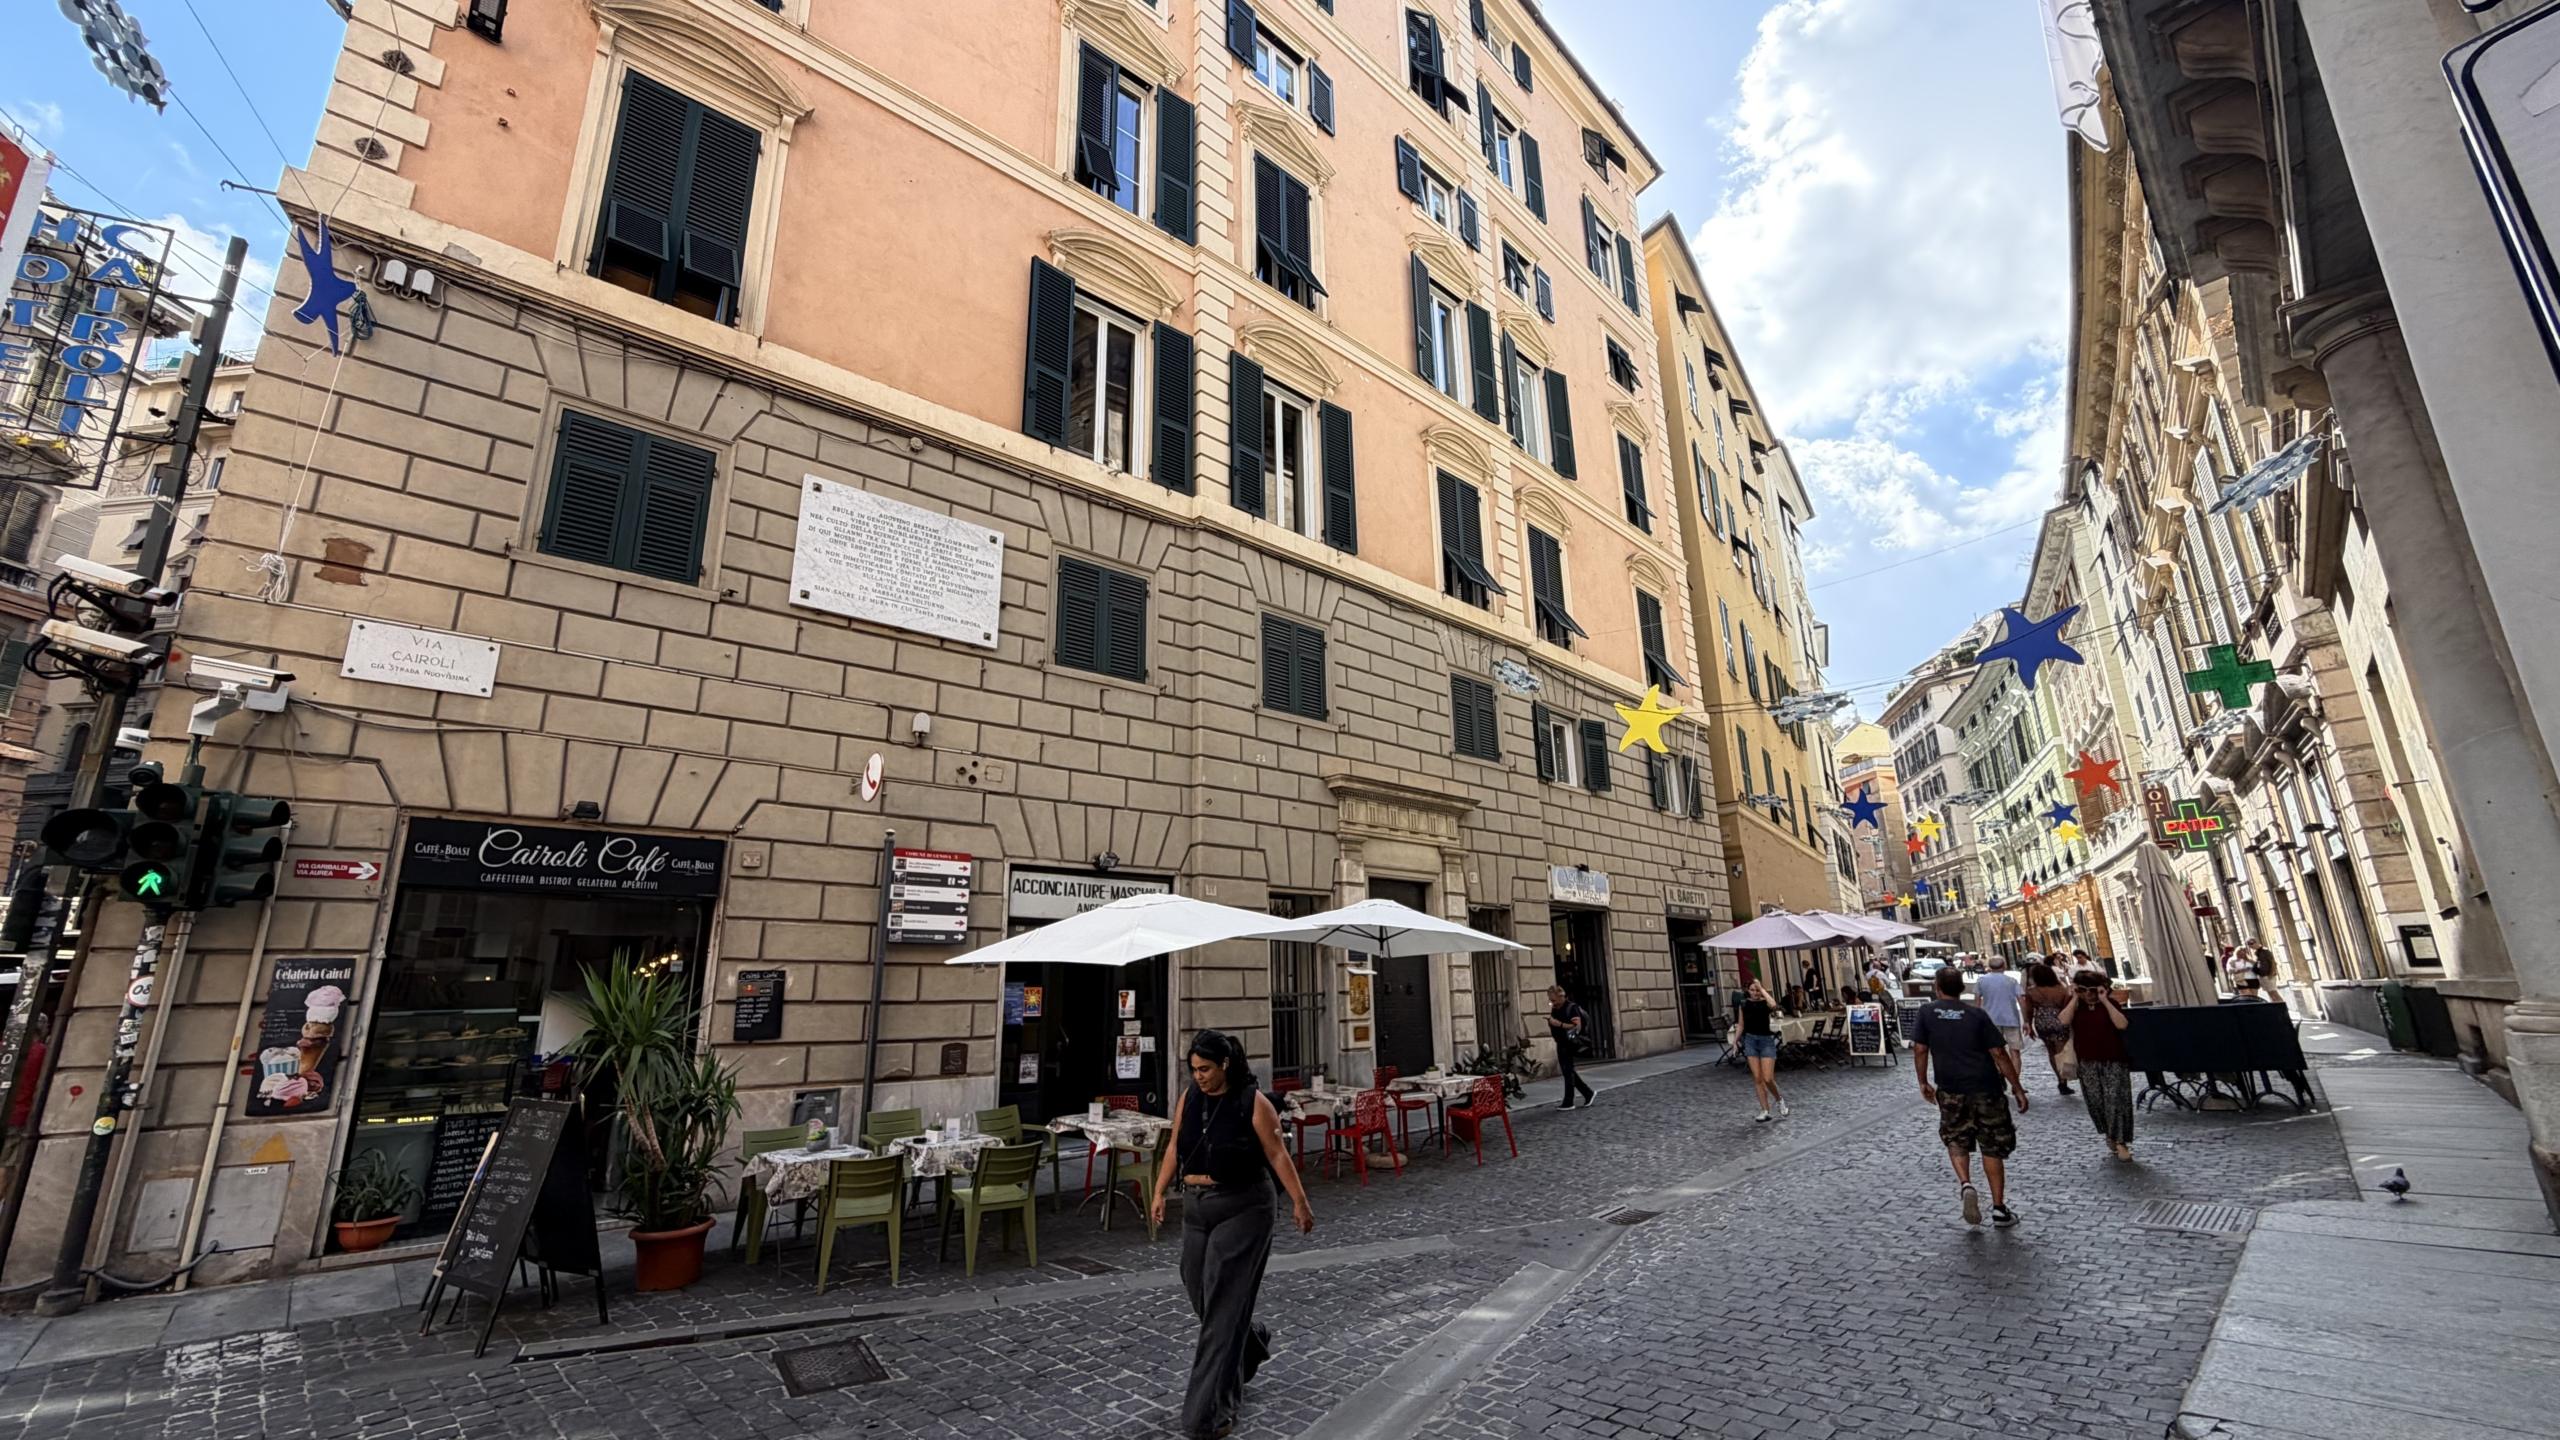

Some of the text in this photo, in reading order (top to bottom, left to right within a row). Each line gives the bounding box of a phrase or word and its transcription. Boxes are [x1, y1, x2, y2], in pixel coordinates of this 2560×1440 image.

[58, 223, 155, 434] CAIROLI
[809, 512, 823, 520] NEL
[825, 516, 848, 527] CULTO
[850, 523, 872, 534] DELLA
[873, 529, 899, 541] SCIENZA
[954, 552, 973, 561] DELLA
[975, 558, 994, 567] PATRIA
[828, 537, 846, 547] ONDE
[847, 529, 862, 538] ANNI
[866, 534, 877, 542] TRA
[866, 515, 893, 527] GENOVA
[897, 524, 917, 534] DALLE
[921, 531, 941, 541] TERRE
[944, 537, 978, 552] LOMBARDE
[873, 523, 885, 531] QUI
[888, 528, 929, 544] NOBILMENTE
[933, 540, 961, 553] OPEROSO
[818, 528, 831, 536] QUI
[834, 532, 855, 542] MOSSE
[858, 538, 890, 552] COSTANTE
[900, 550, 919, 559] TUTTE
[932, 558, 967, 572] MAGNANIME
[971, 569, 993, 579] IMPRESE
[825, 549, 840, 558] NON
[843, 554, 892, 571] DIMENTICABILE
[895, 567, 926, 580] COMITATO
[828, 557, 842, 565] CHE
[877, 569, 897, 579] SPINSE
[901, 575, 911, 583] GLI
[914, 579, 936, 589] ARMATI
[873, 555, 892, 565] DIEDE
[895, 561, 909, 569] VITA
[923, 568, 949, 580] IMPULSO
[862, 572, 883, 582] SULLA
[899, 581, 910, 589] DEI
[913, 585, 942, 596] MIRACOLI
[875, 582, 929, 600] DUCE GARIBALDI
[814, 584, 830, 593] SIAN
[833, 589, 854, 599] SACRE
[869, 597, 888, 606] MURA
[900, 604, 912, 612] CUI
[914, 608, 933, 617] TANTA
[936, 613, 957, 622] STORIA
[960, 618, 981, 628] RIPOSA
[871, 587, 902, 599] MARSALA
[911, 597, 944, 609] VOLTURNO
[411, 634, 442, 650] VIA
[392, 650, 456, 669] CAIROLI
[478, 826, 670, 881] Cairoli Café
[480, 872, 659, 890] CAFFETTERIA BISTROT GELATERIA APERITIVI
[275, 967, 351, 981] Gelateria Cairoli
